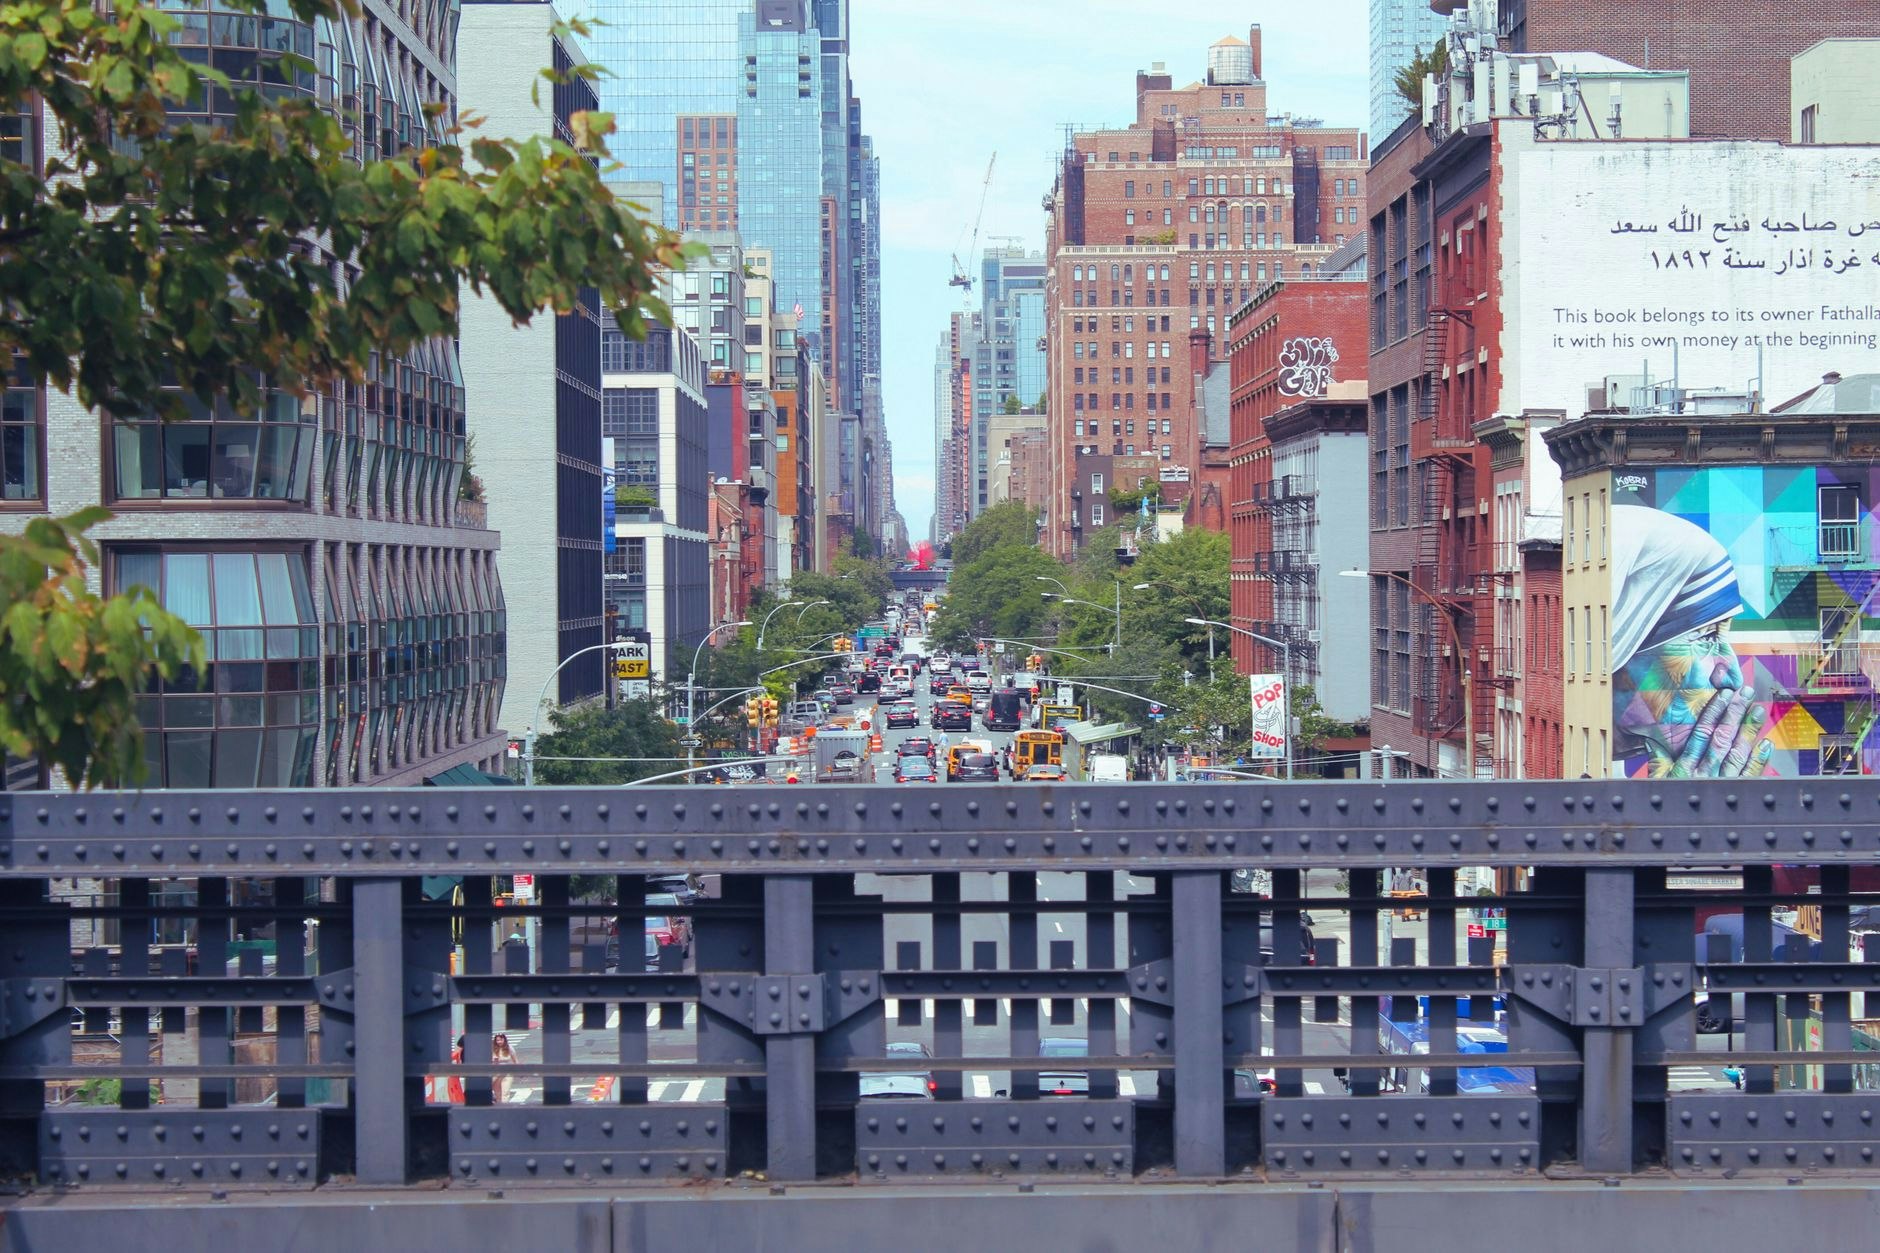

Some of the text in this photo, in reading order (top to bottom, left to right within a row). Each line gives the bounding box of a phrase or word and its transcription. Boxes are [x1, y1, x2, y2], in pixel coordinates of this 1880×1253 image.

[1611, 219, 1658, 234] سعد
[1668, 204, 1701, 232] الله
[1713, 213, 1750, 243] فتح
[1761, 212, 1837, 238] صاحبه
[1651, 250, 1711, 270] ١٨٩٢
[1723, 247, 1765, 268] سنة
[1774, 248, 1813, 275] اذار
[1824, 248, 1861, 274] غرة
[1553, 308, 1588, 323] This
[1594, 308, 1637, 323] book
[1643, 307, 1706, 327] belongs
[1711, 310, 1729, 322] to
[1736, 308, 1754, 322] its
[1761, 310, 1814, 321] owner
[1553, 331, 1877, 350] it with his own money at the beginning
[1615, 475, 1648, 486] KOBRA
[615, 634, 636, 642] dison
[1253, 683, 1282, 709] POP
[1253, 730, 1284, 748] SHOP
[1492, 919, 1499, 928] 18
